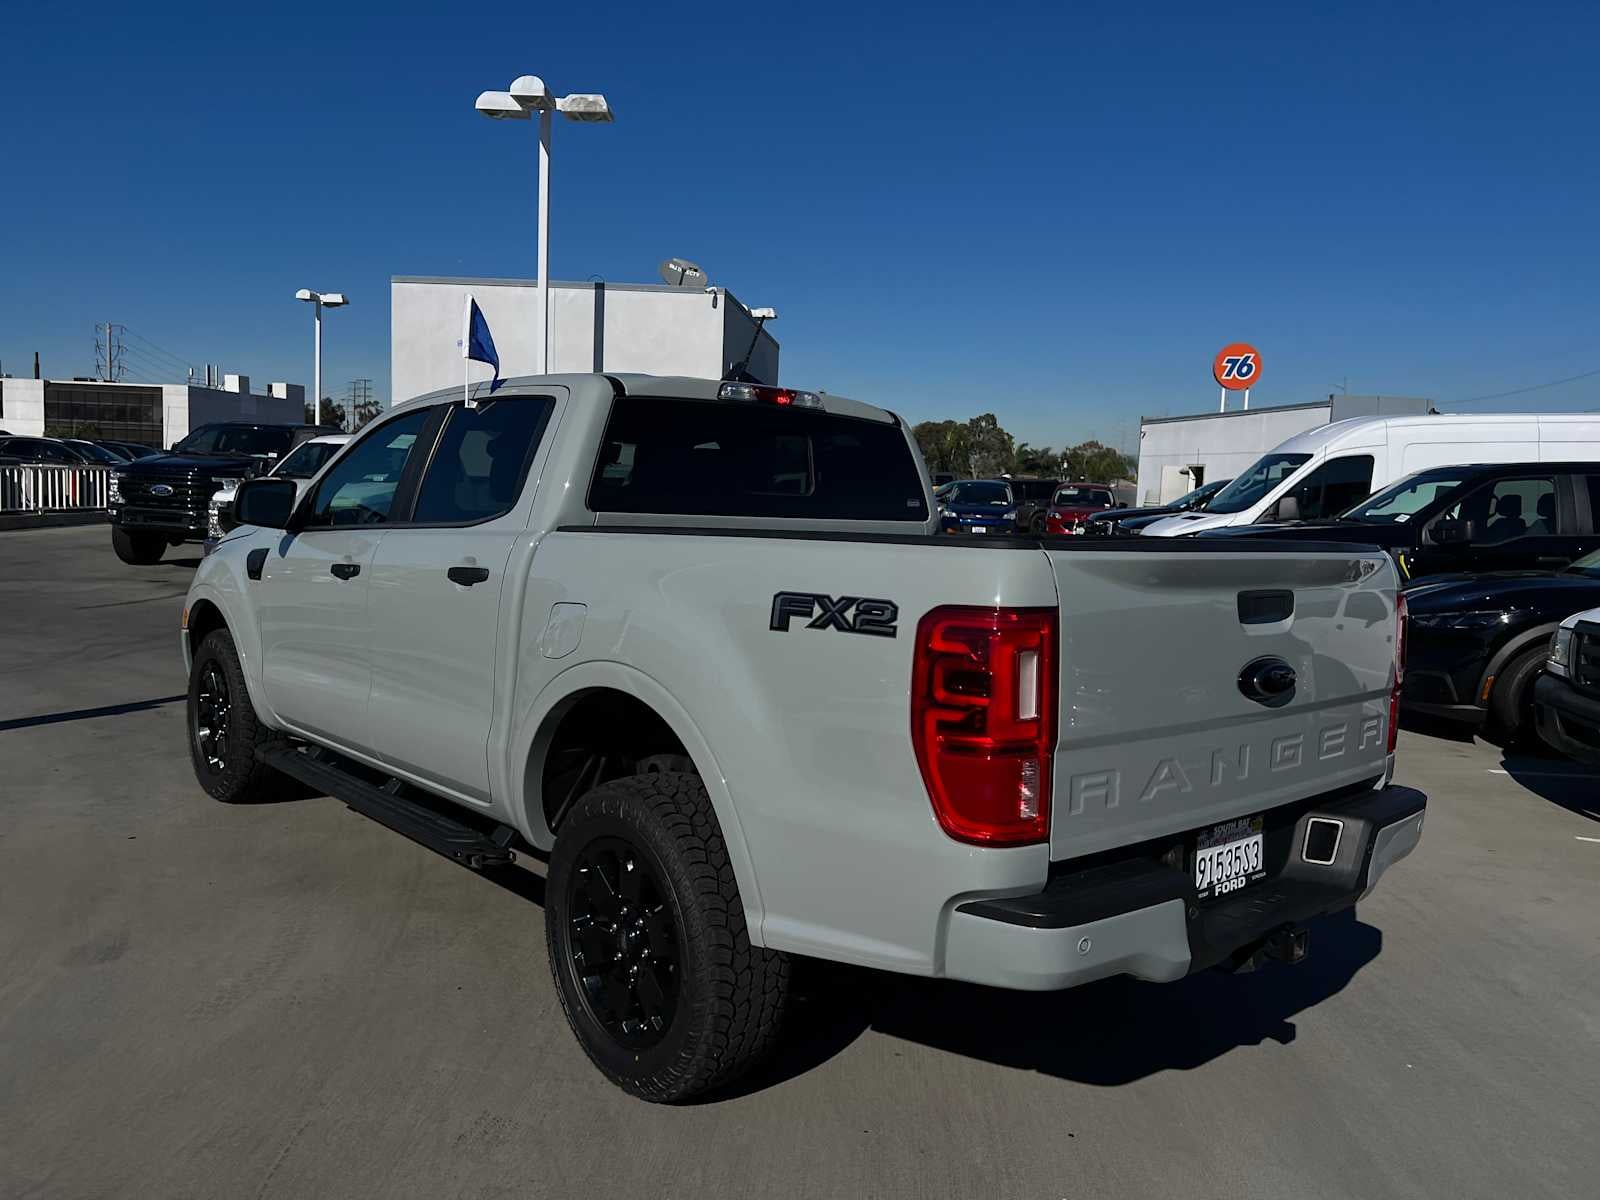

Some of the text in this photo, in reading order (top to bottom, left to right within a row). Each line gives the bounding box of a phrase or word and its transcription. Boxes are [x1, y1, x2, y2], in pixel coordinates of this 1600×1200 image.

[1221, 353, 1256, 380] 76
[769, 591, 899, 639] FX2
[1069, 715, 1384, 816] RANGER
[1196, 840, 1259, 889] 91535S3
[1214, 876, 1246, 896] FORD
